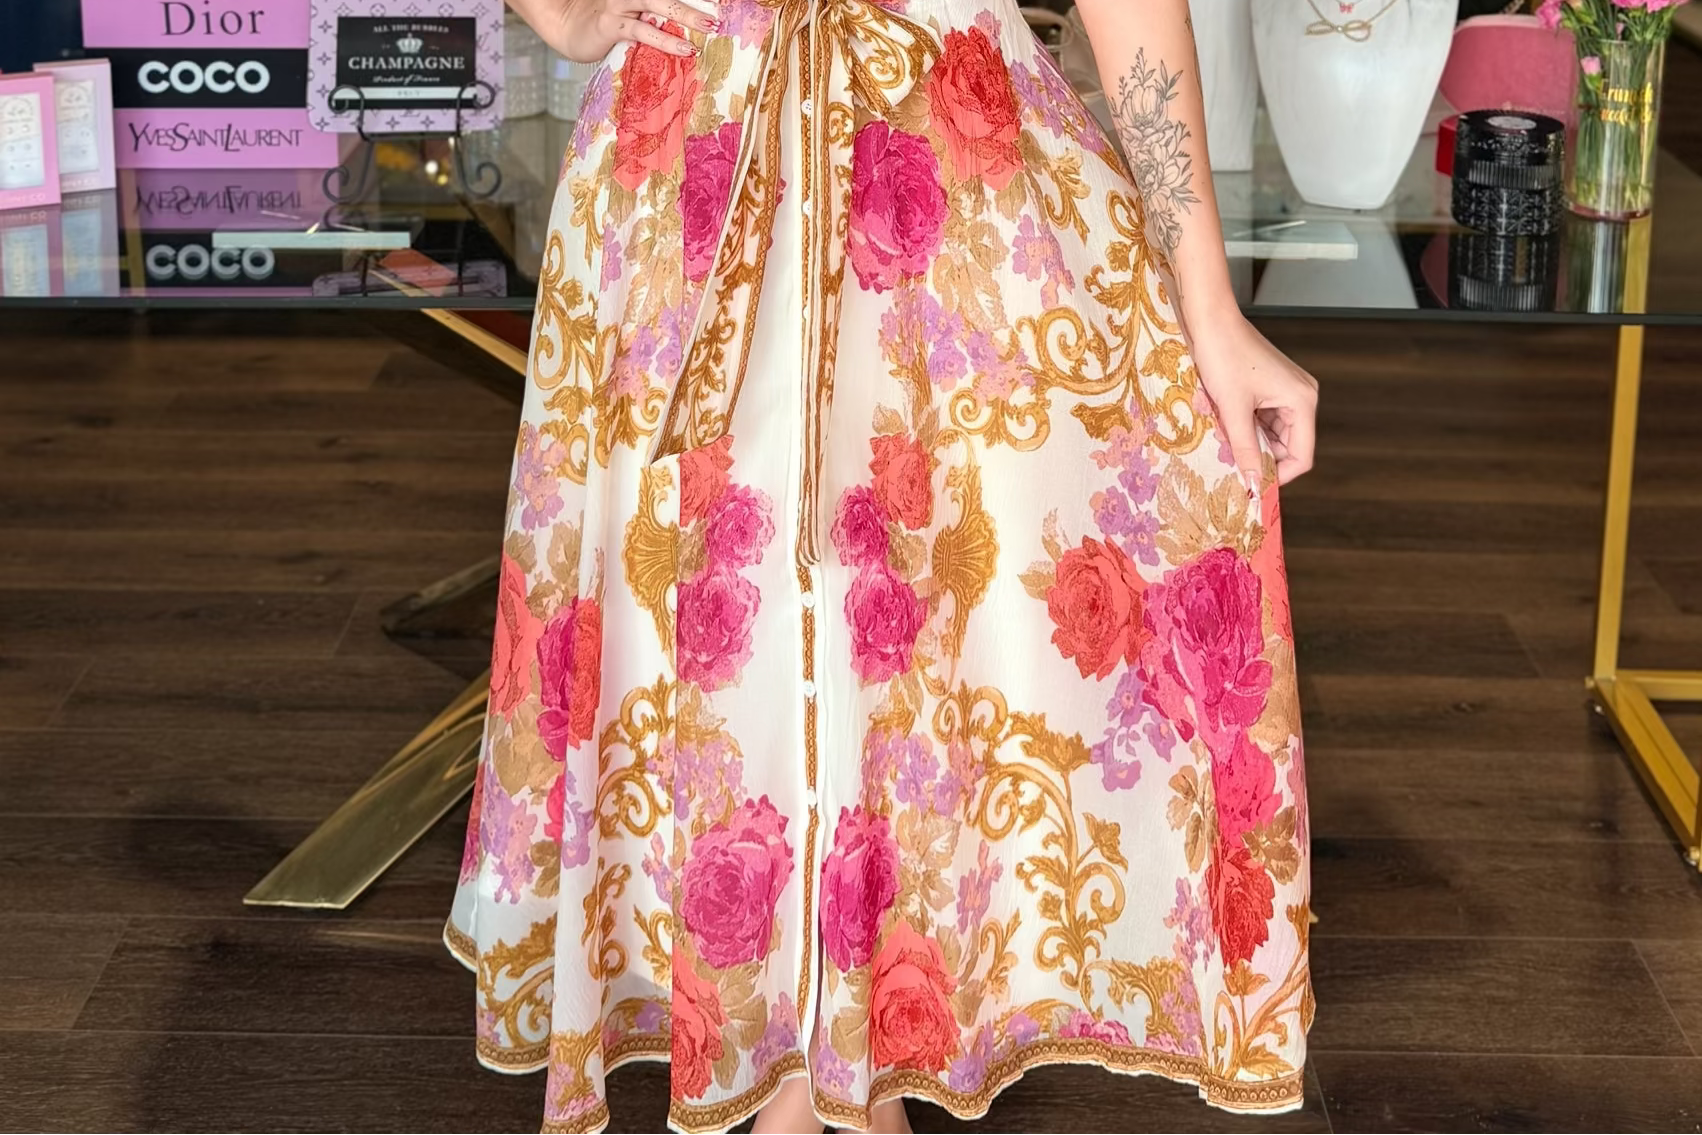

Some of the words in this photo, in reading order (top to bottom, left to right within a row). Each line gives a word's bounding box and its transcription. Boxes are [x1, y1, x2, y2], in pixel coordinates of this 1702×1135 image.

[160, 0, 265, 36] Dior
[137, 60, 271, 94] COCO
[348, 56, 465, 70] CHAMPAGNE
